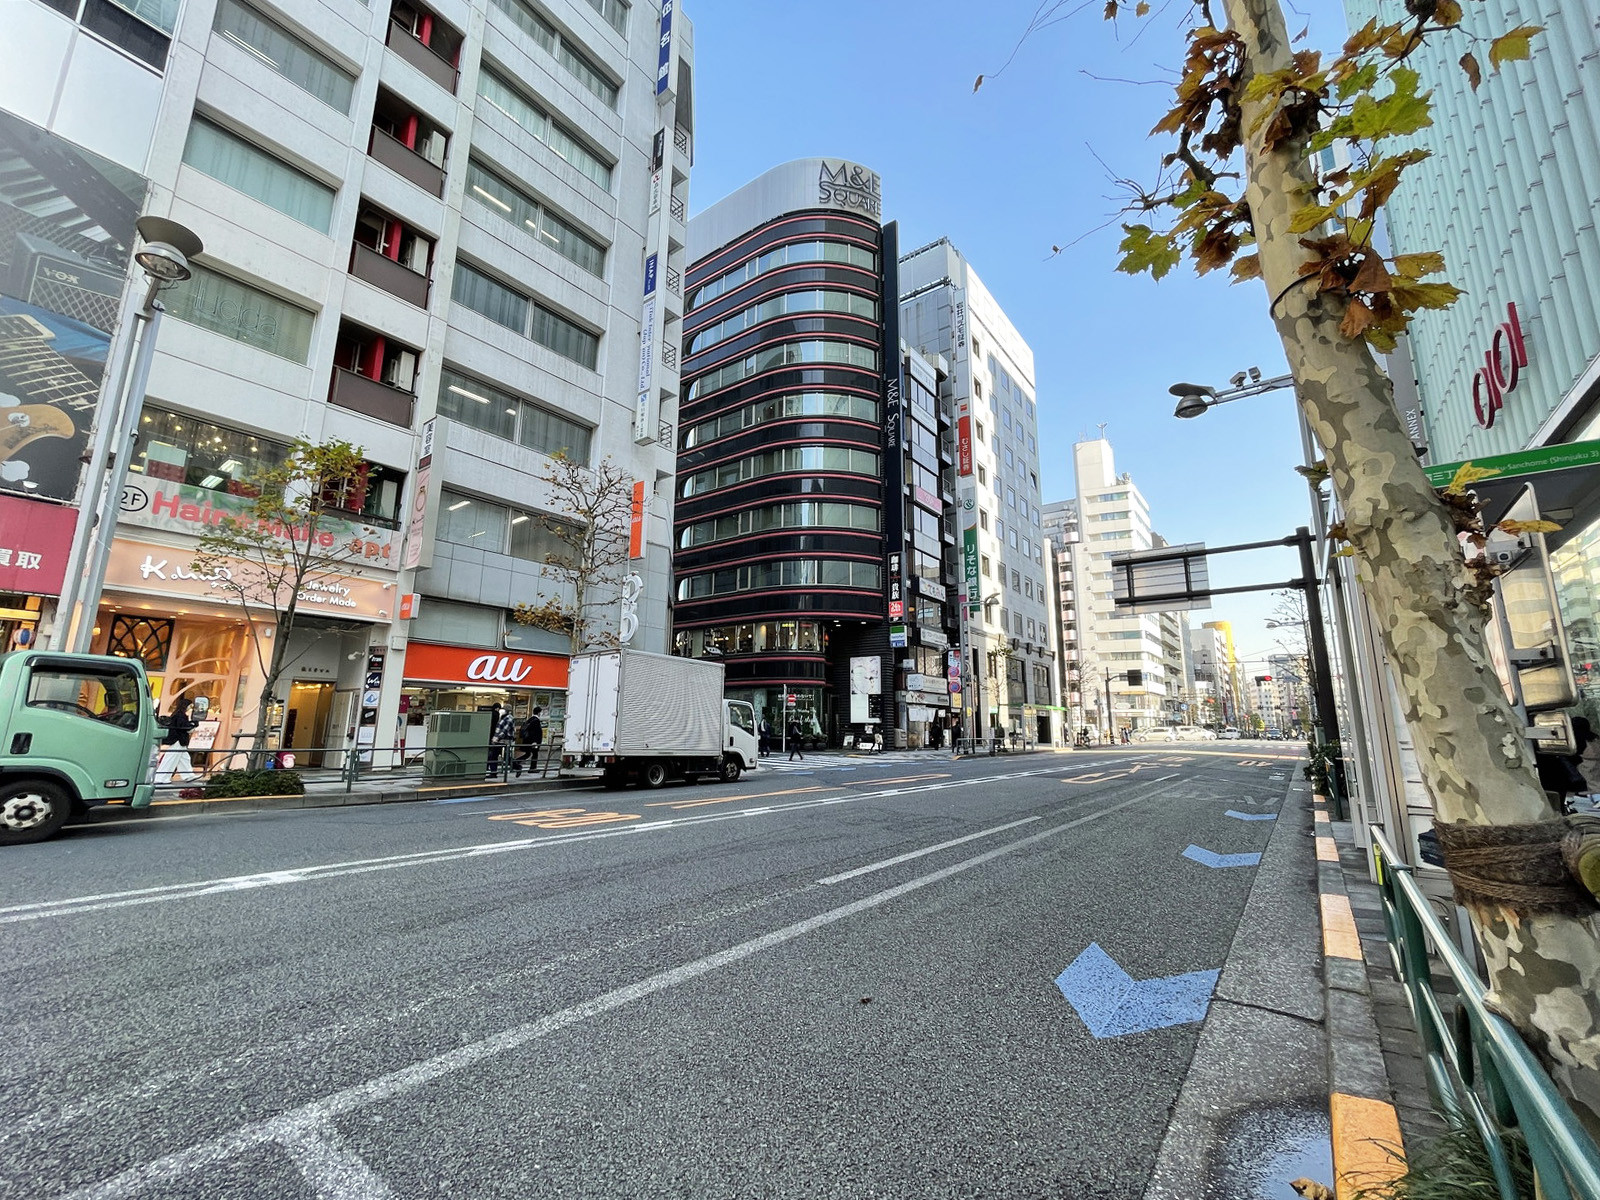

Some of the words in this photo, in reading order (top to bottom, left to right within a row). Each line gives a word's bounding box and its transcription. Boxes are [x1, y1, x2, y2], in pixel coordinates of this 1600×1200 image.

[819, 160, 881, 197] M&E
[819, 181, 881, 216] SQUARE
[43, 267, 80, 285] VOX
[1405, 408, 1421, 439] ANNEX
[121, 491, 142, 506] 2F
[152, 490, 229, 526] Hair
[966, 543, 978, 600] りそな銀行
[296, 591, 327, 604] Order
[329, 595, 357, 608] Made
[306, 581, 351, 598] Jewelry
[467, 655, 533, 682] au
